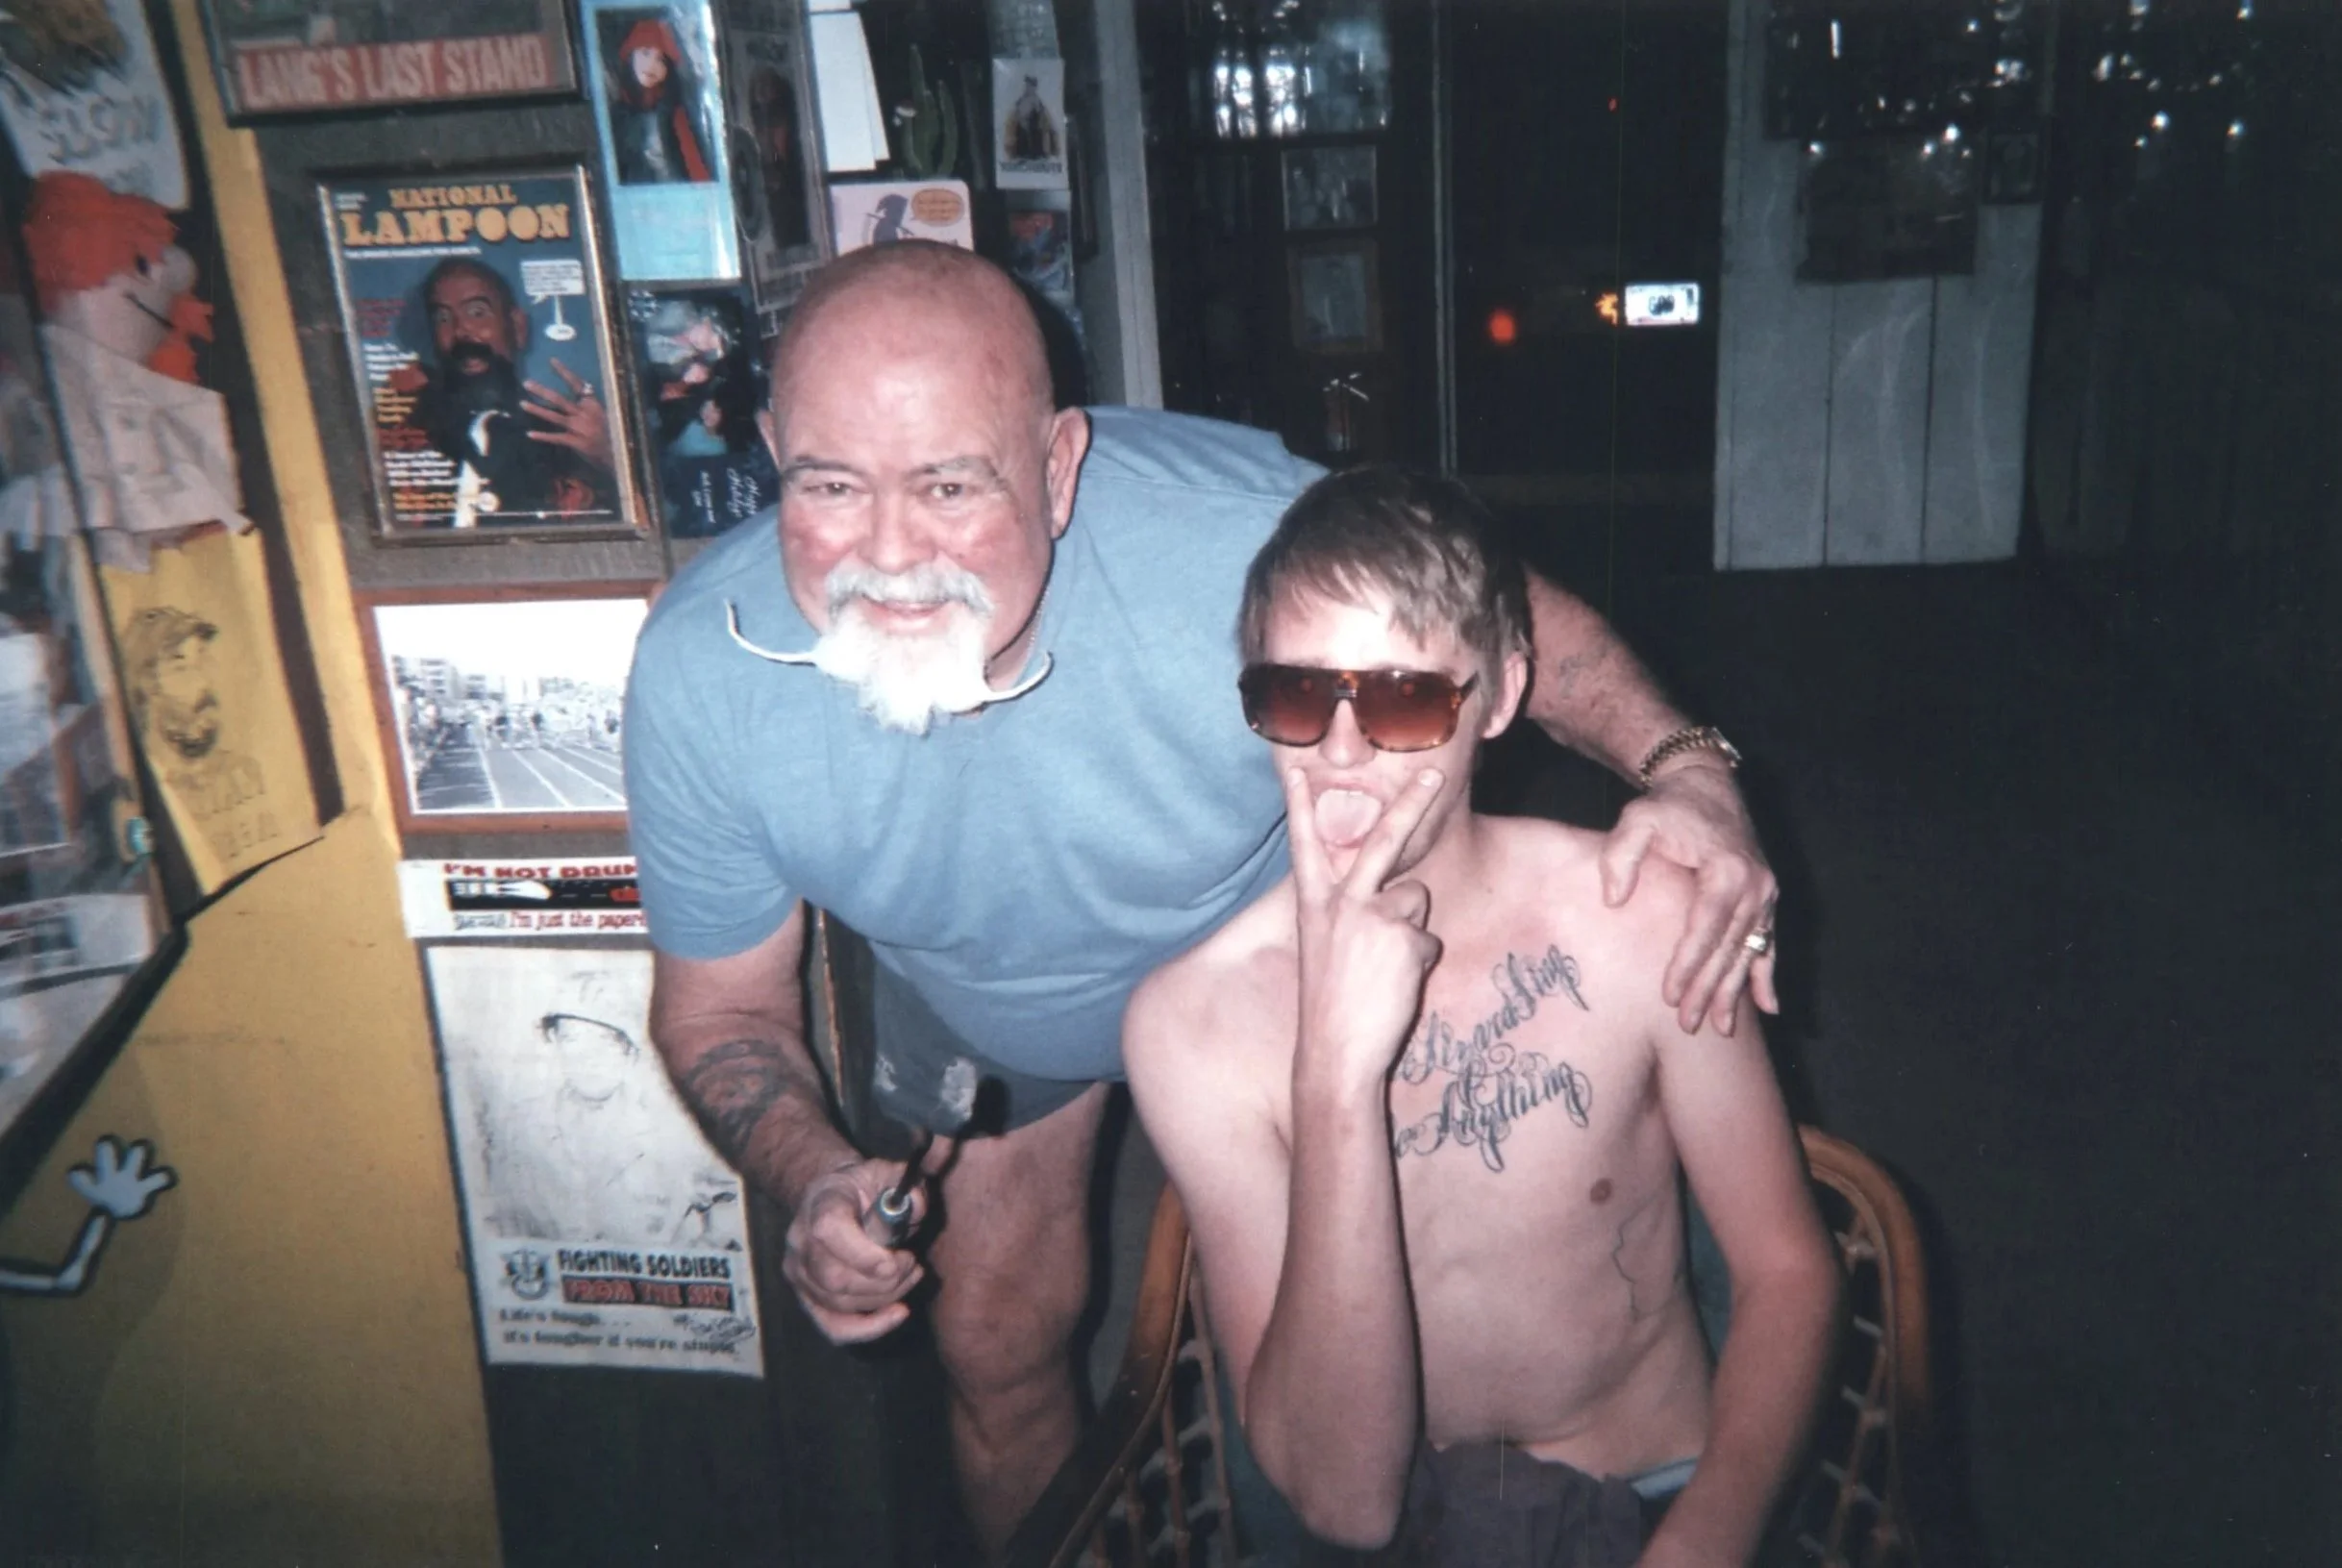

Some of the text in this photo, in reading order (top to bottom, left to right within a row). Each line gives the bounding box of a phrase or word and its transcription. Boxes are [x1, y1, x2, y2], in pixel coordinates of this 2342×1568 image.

[237, 34, 547, 110] LANG'S LAST STAND
[388, 184, 517, 209] NATIONAL
[340, 203, 569, 246] LAMPOON
[444, 863, 486, 877] I'M
[494, 865, 552, 880] NOT
[536, 912, 564, 931] just
[569, 912, 593, 928] the
[557, 1249, 732, 1280] FIGHTING SOLDIERS
[562, 1279, 731, 1307] FROM THE SKY
